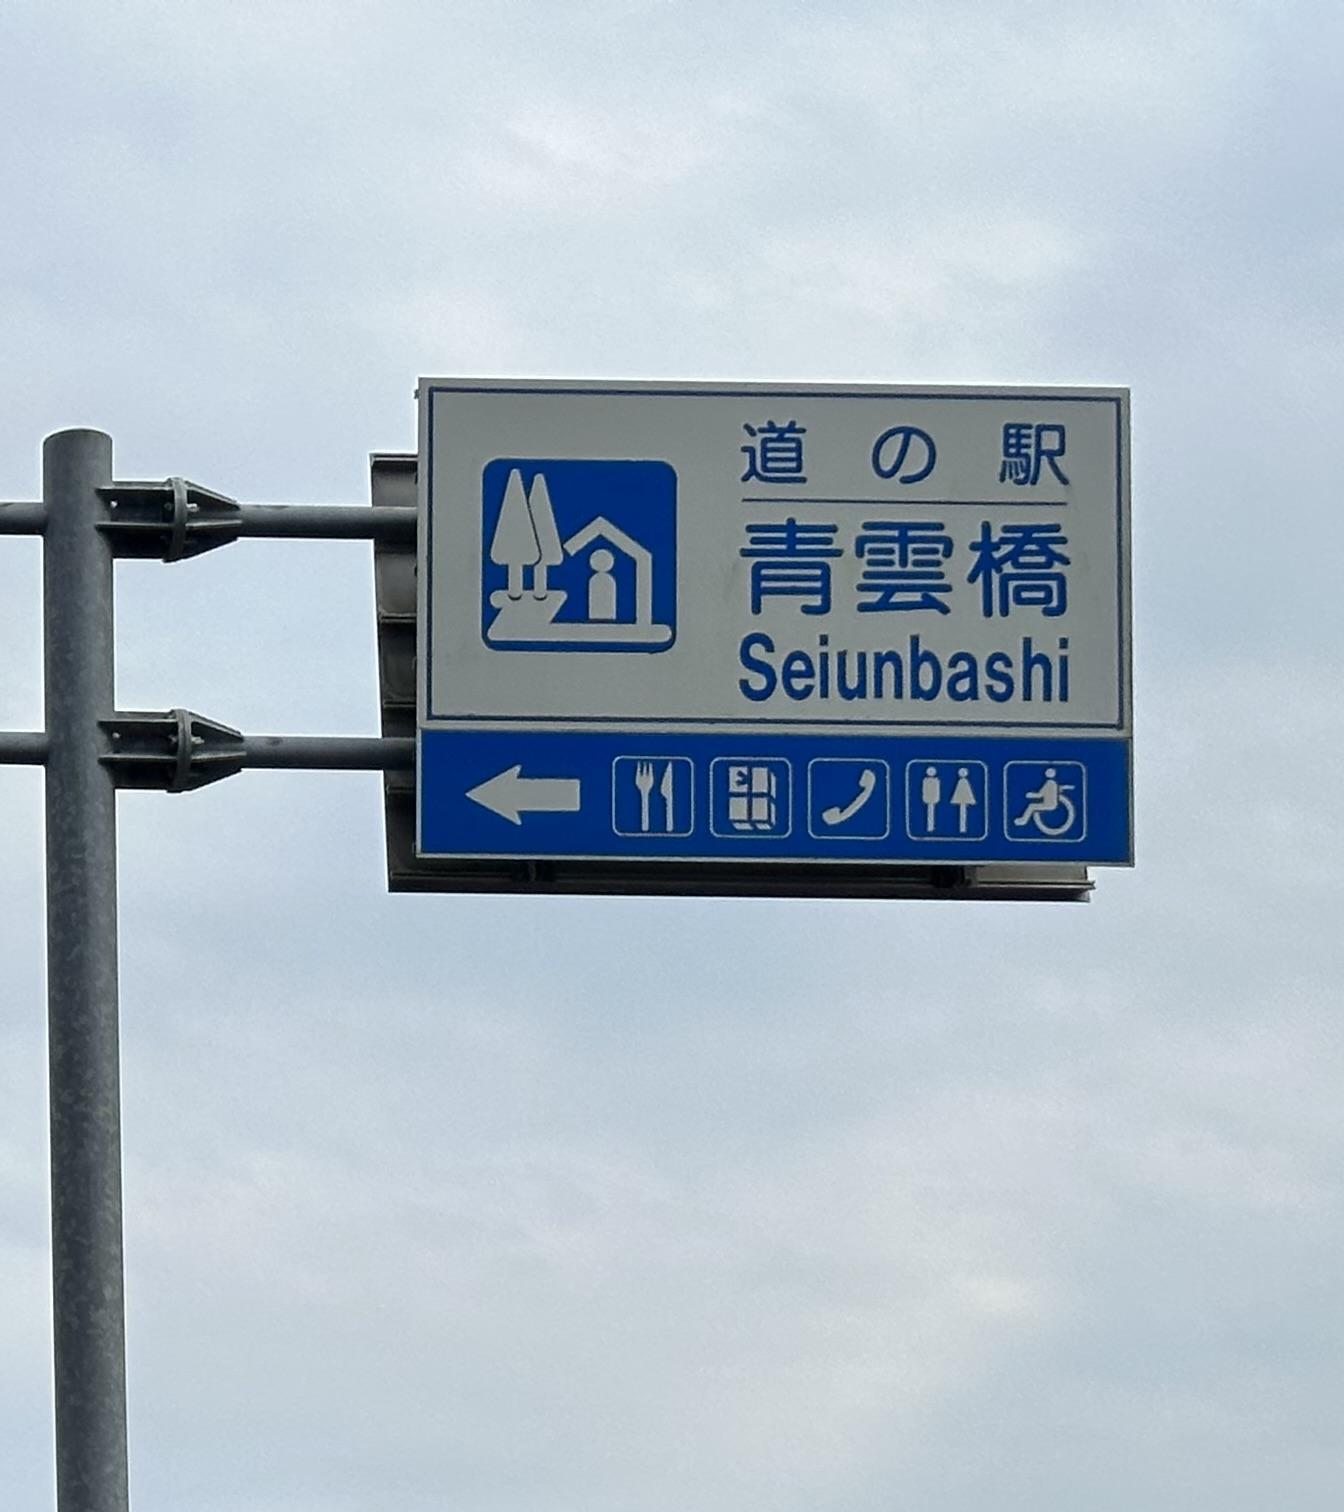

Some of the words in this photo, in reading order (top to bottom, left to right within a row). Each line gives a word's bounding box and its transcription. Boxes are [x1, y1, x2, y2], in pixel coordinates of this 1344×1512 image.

[741, 421, 1070, 487] 道の駅
[740, 518, 1071, 618] 青雲橋
[739, 632, 1069, 703] Seiunbashi
